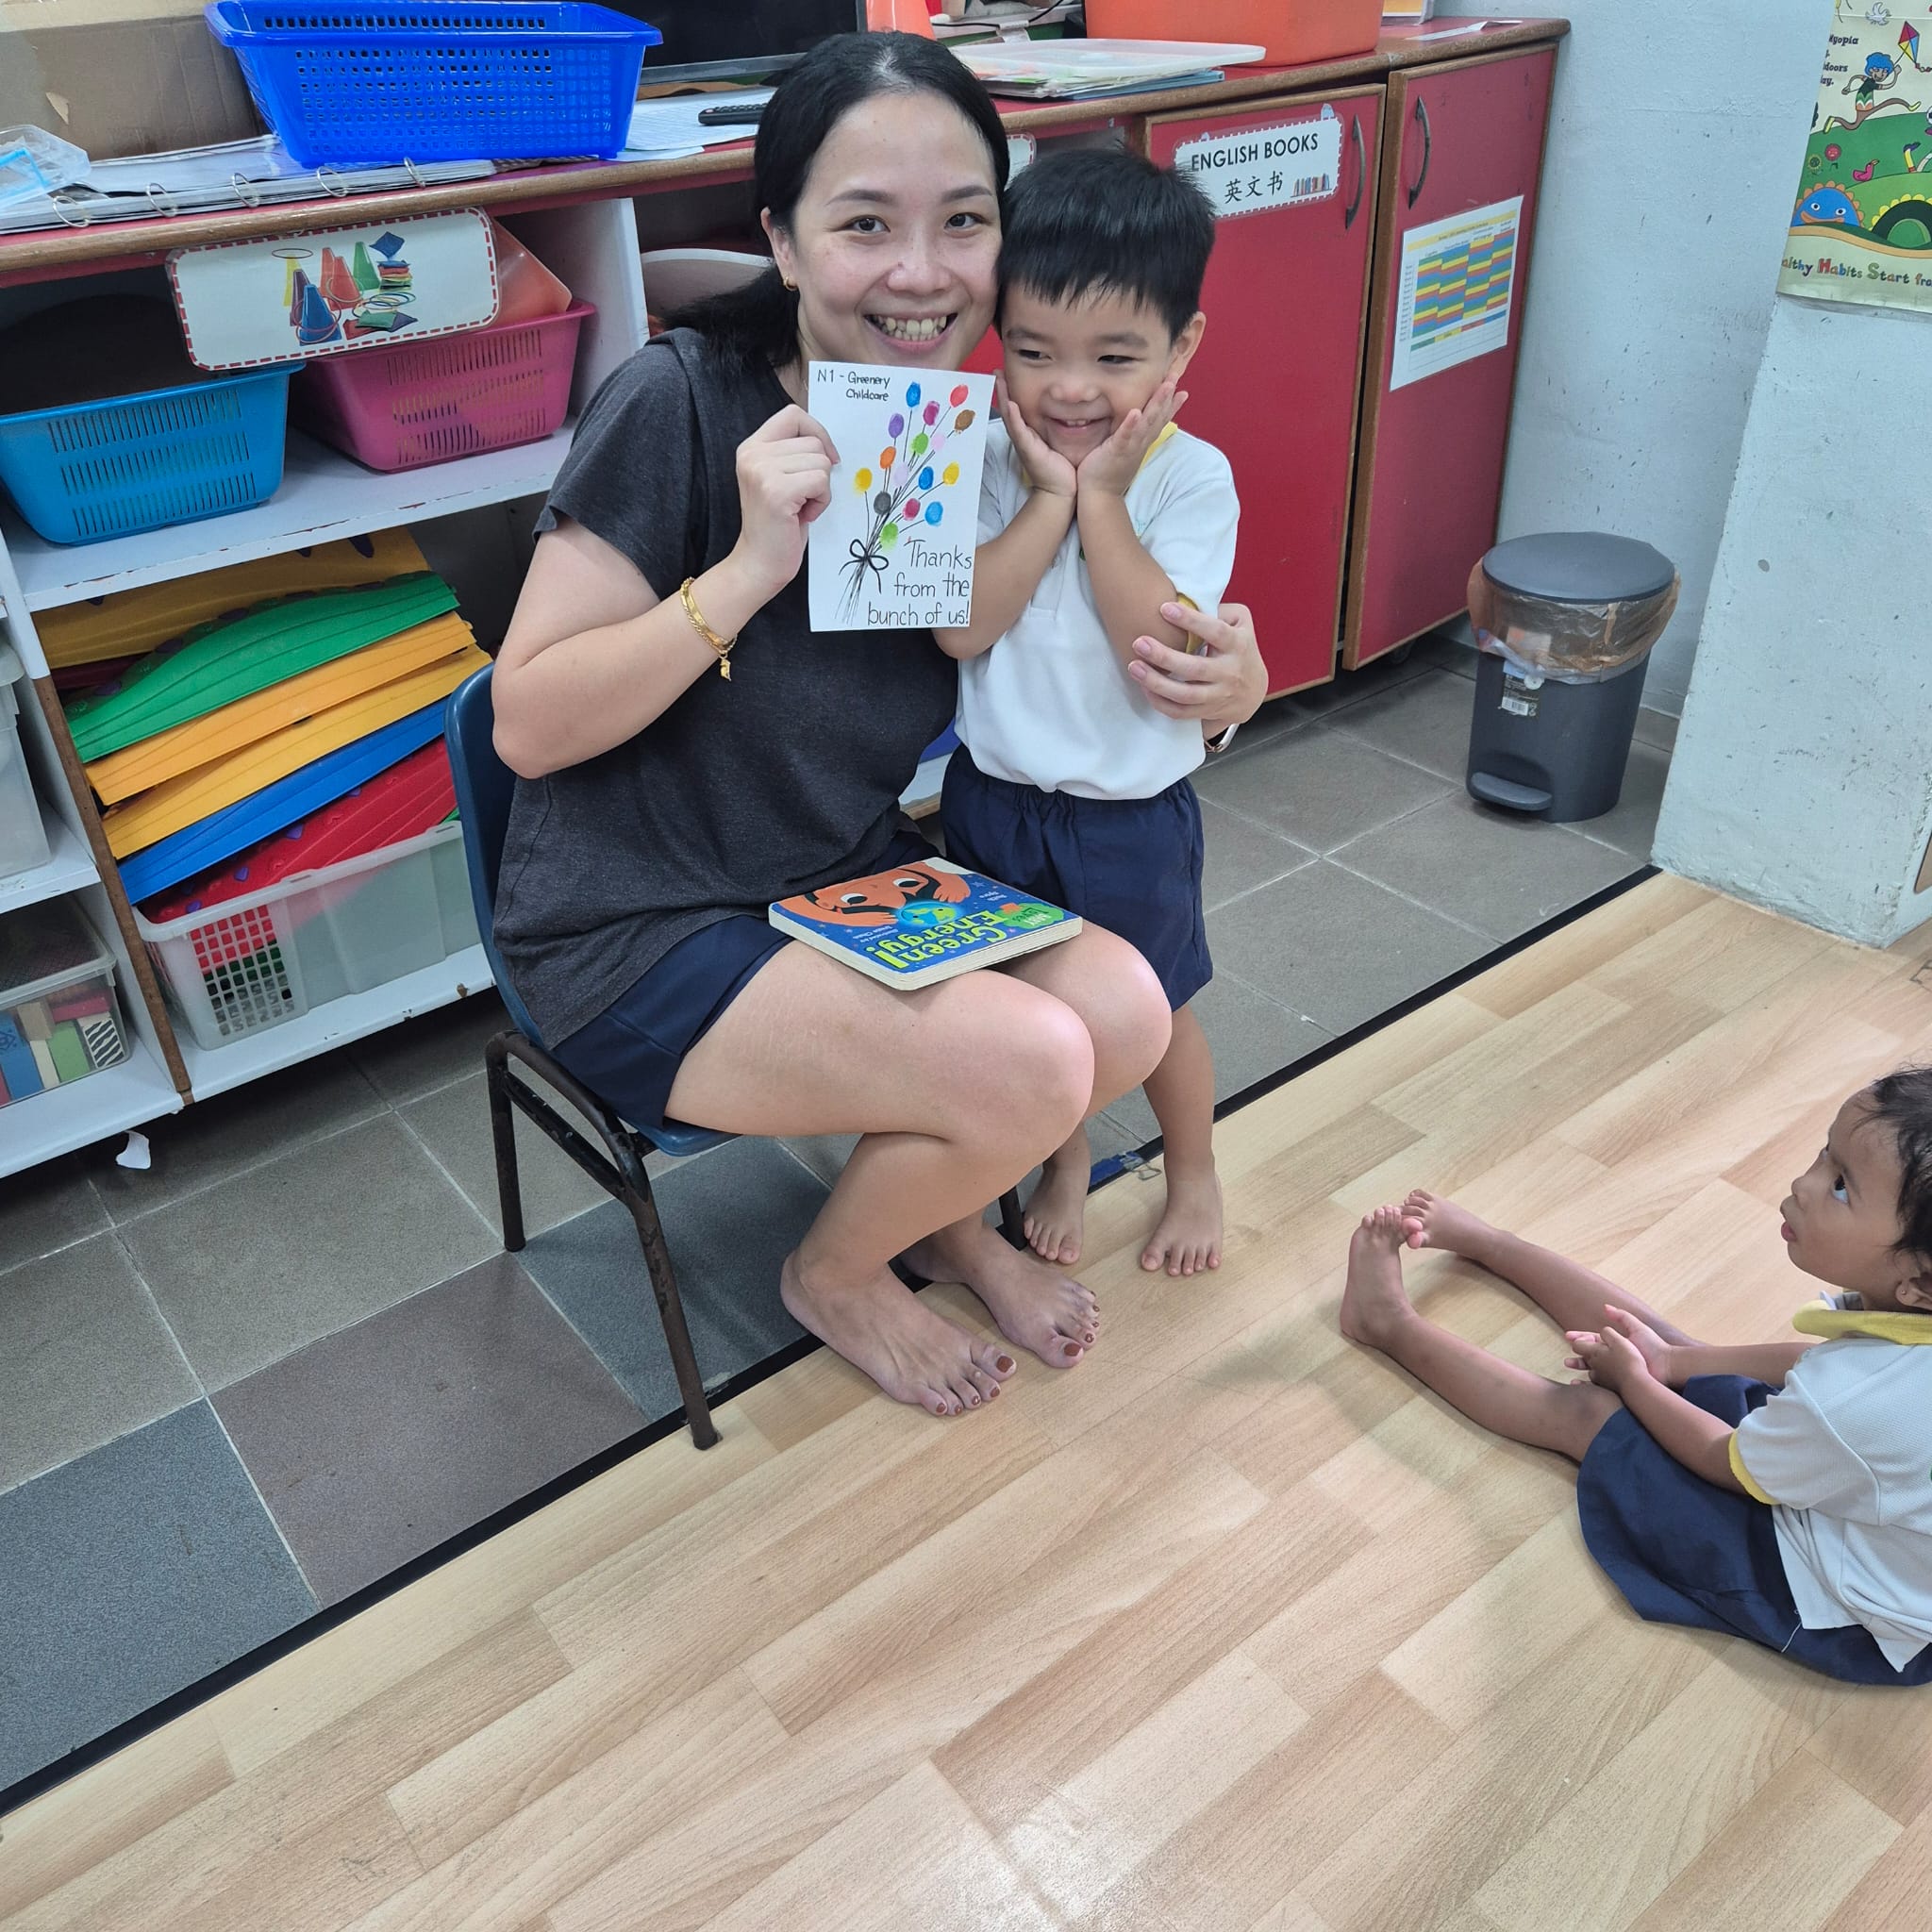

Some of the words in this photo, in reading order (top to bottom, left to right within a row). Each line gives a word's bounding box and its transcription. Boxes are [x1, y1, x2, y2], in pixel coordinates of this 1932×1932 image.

[1191, 143, 1258, 171] ENGLISH
[1264, 133, 1319, 159] BOOKS
[1224, 170, 1284, 205] 英文书
[1817, 258, 1863, 278] Habits
[1867, 262, 1910, 284] Start
[1914, 273, 1932, 287] fro
[817, 369, 835, 383] N1
[847, 371, 891, 389] Greenery
[845, 389, 890, 402] Childcare
[904, 539, 973, 569] Thanks
[893, 572, 936, 597] from
[942, 572, 970, 598] the
[867, 601, 919, 626] bunch
[924, 602, 942, 625] of
[947, 602, 970, 626] us!
[898, 925, 1008, 962] Green
